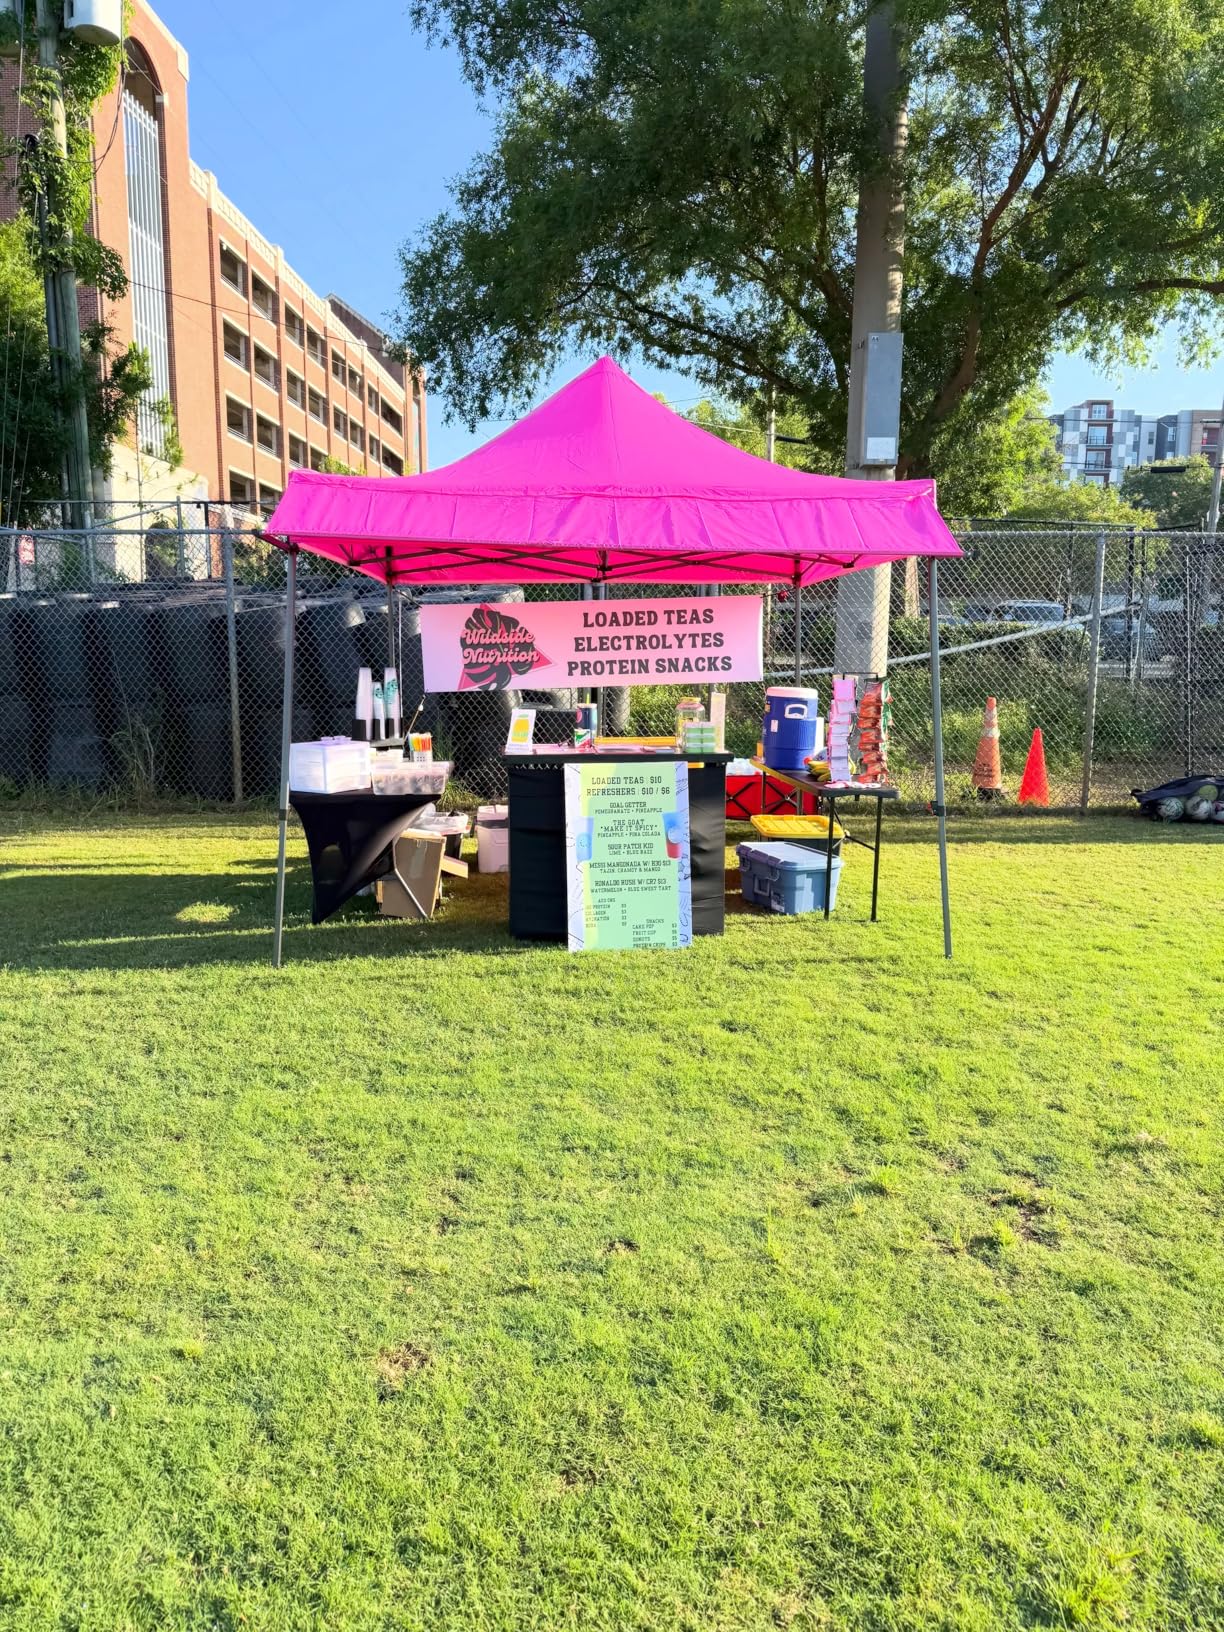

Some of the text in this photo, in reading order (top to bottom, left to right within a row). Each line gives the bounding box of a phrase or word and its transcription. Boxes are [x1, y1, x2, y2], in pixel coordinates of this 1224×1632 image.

[583, 608, 714, 628] LOADED TEAS
[462, 628, 536, 645] Wildside
[573, 632, 724, 652] ELECTROLYTES
[463, 648, 540, 665] Nutrition
[567, 656, 732, 676] PROTEIN SNACKS
